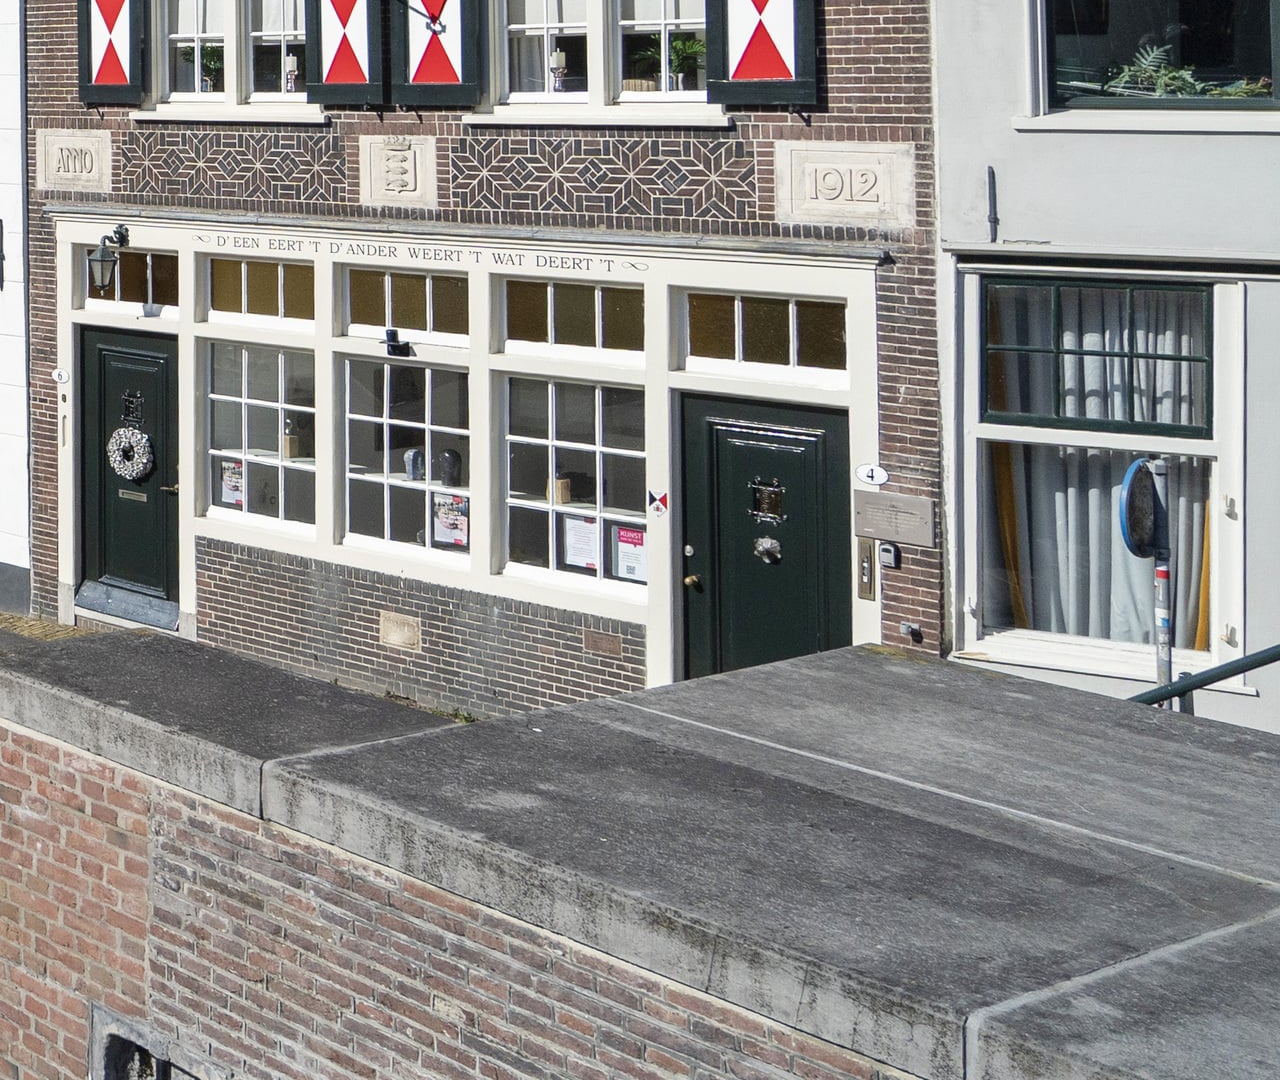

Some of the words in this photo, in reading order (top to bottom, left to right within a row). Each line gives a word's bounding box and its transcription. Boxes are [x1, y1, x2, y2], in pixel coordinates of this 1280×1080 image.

[55, 147, 94, 174] ANNO
[808, 167, 880, 203] 1912
[268, 239, 305, 252] EERT
[407, 247, 463, 262] WEERT
[492, 252, 526, 267] WAT
[535, 255, 593, 271] DEERT
[57, 371, 63, 381] 6
[866, 468, 875, 481] 4
